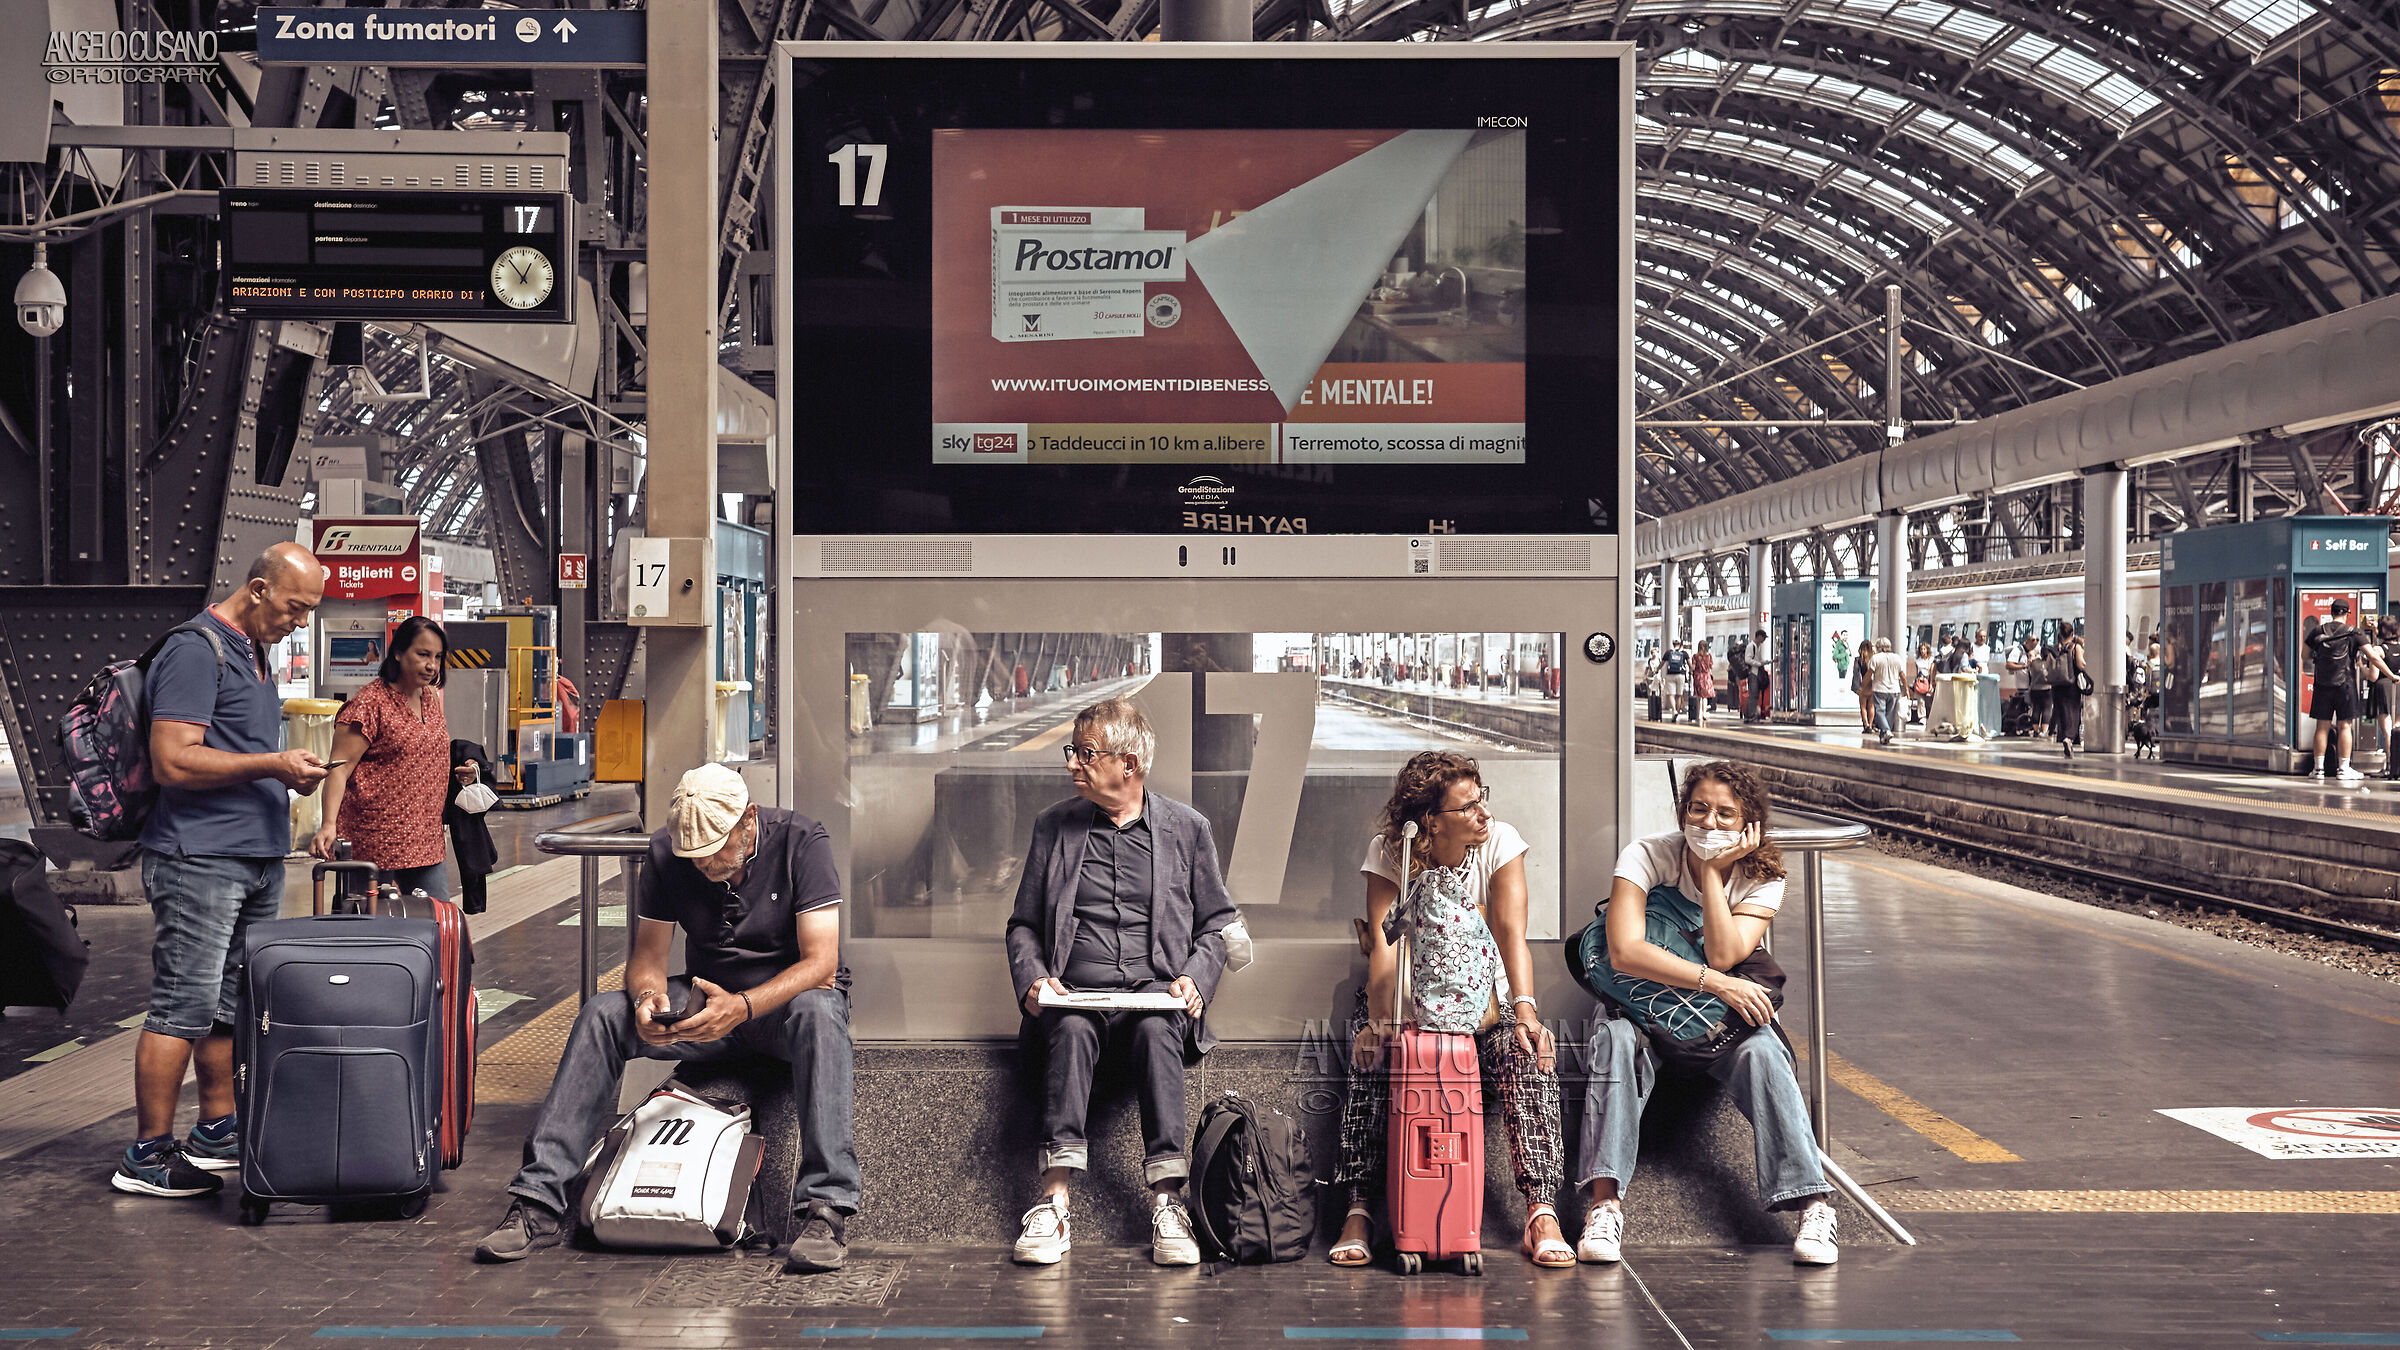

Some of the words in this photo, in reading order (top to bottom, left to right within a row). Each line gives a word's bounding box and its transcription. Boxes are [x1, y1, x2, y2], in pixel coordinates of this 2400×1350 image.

[275, 15, 354, 40] Zona
[365, 14, 496, 40] fumatori
[1477, 116, 1528, 128] IMECON
[828, 144, 888, 206] 17
[515, 206, 541, 234] 17
[1012, 213, 1018, 223] 1
[1021, 215, 1041, 223] MESE
[1043, 215, 1052, 223] DI
[1053, 215, 1087, 224] UTILIZZO
[1015, 239, 1173, 271] Prostamol
[232, 287, 292, 297] ARIAZIONI
[300, 288, 307, 297] E
[314, 288, 336, 298] CON
[344, 289, 405, 299] POSTICIPO
[413, 289, 453, 299] ORARIO
[461, 290, 473, 300] DI
[1094, 311, 1105, 320] 30
[991, 379, 1273, 392] WWW.ITUOIMOMENTIDIBENESS
[1321, 380, 1433, 405] MENTALE!
[942, 434, 971, 452] sky
[977, 436, 1014, 452] tg24
[1040, 435, 1126, 451] Taddeucci
[1131, 436, 1145, 450] in
[1149, 436, 1169, 451] 10
[1174, 435, 1199, 450] km
[1203, 435, 1265, 451] a.libere
[1289, 436, 1383, 453] Terremoto,
[1387, 439, 1445, 451] scossa
[1449, 436, 1465, 451] di
[1178, 485, 1235, 494] GrandiStazioni
[348, 544, 402, 552] TRENITALIA
[2325, 539, 2348, 551] Self
[2349, 539, 2369, 551] Bar
[339, 566, 394, 581] Biglietti
[636, 563, 666, 588] 17
[339, 580, 364, 589] Tickets
